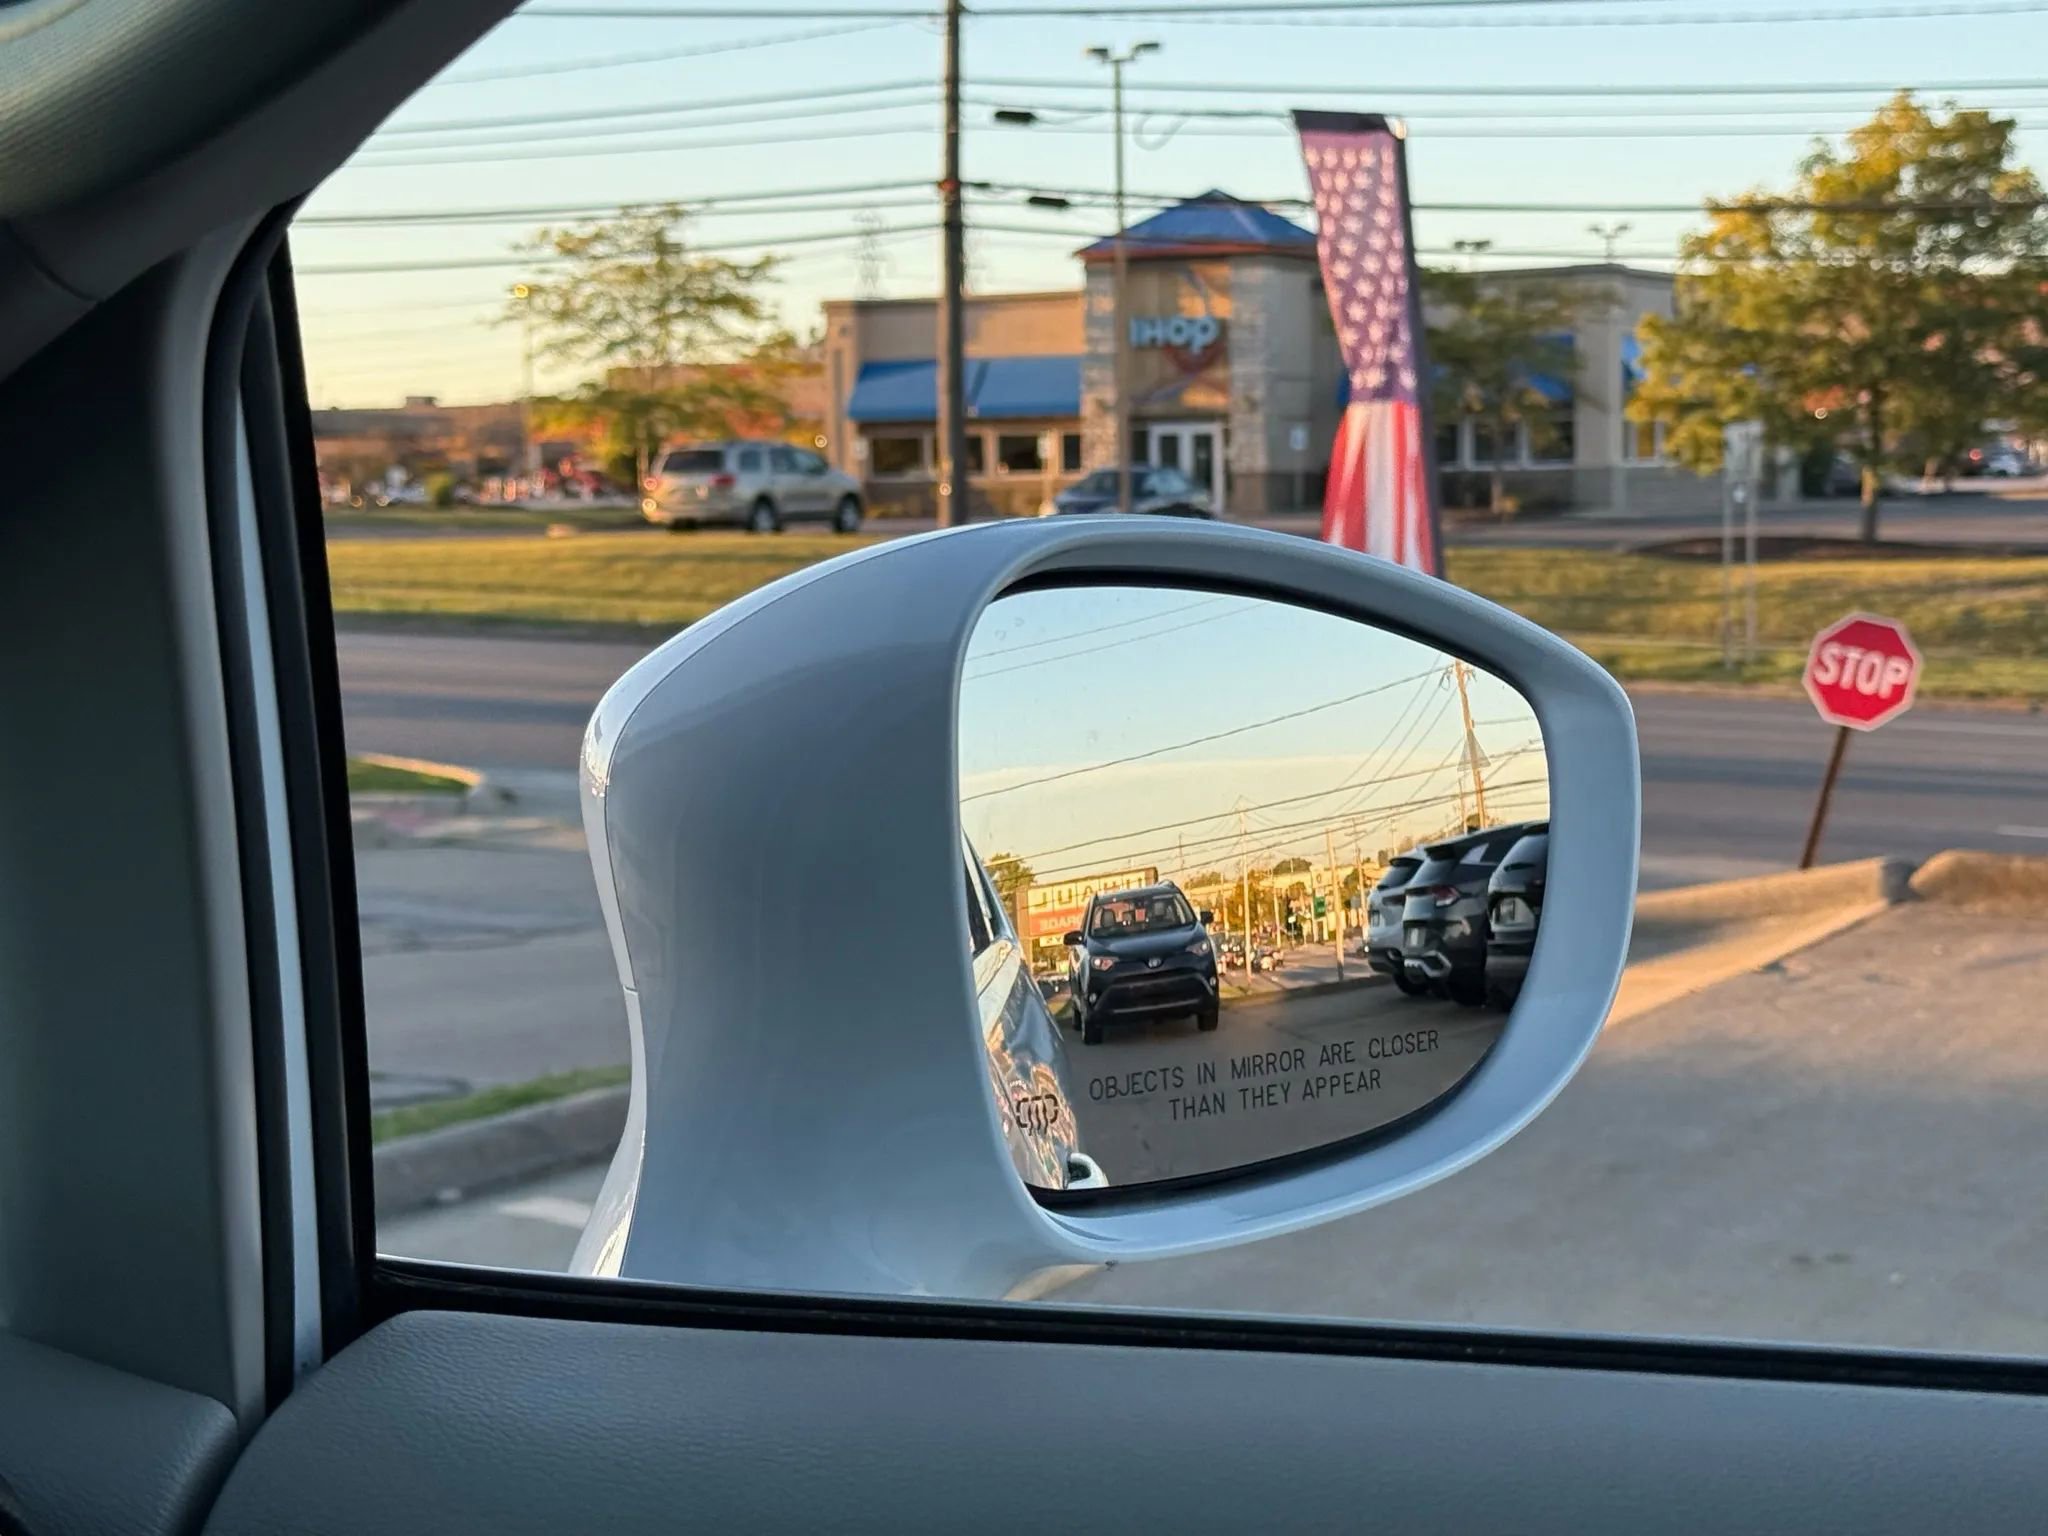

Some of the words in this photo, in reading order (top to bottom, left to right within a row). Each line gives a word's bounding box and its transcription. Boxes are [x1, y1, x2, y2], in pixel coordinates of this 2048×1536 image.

[1814, 641, 1910, 699] STOP
[1090, 1066, 1185, 1101] OBJECTS
[1198, 1062, 1216, 1085] IN
[1231, 1048, 1305, 1080] MIRROR
[1320, 1041, 1355, 1067] ARE
[1368, 1030, 1439, 1059] CLOSER
[1169, 1091, 1226, 1121] THAN
[1238, 1081, 1291, 1110] THEY
[1302, 1068, 1382, 1101] APPEAR
